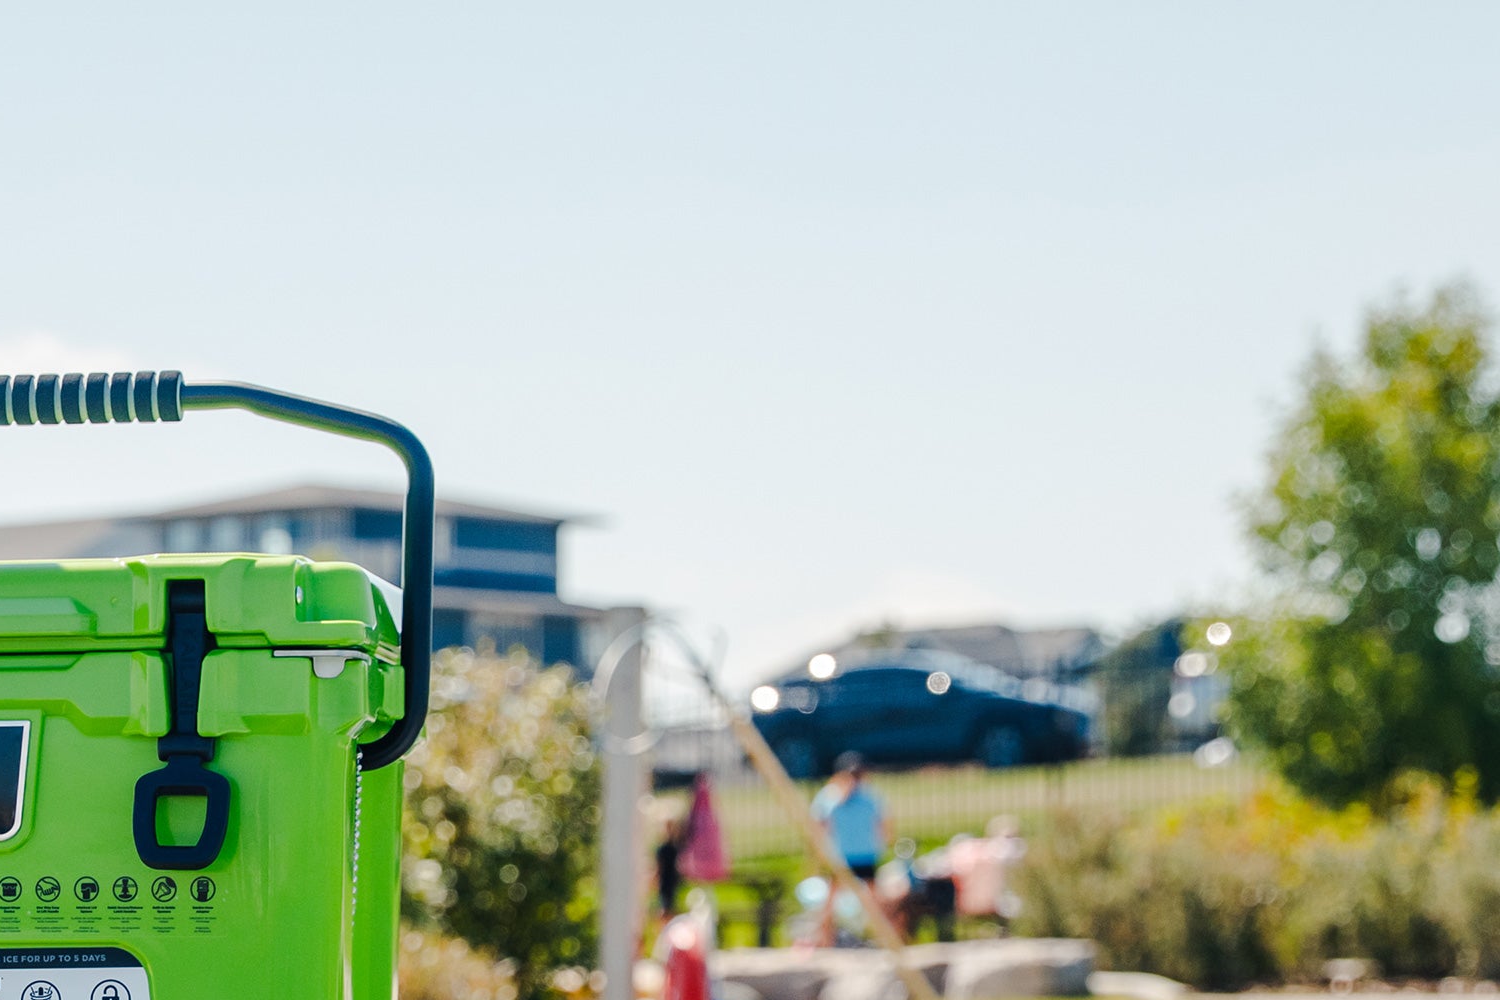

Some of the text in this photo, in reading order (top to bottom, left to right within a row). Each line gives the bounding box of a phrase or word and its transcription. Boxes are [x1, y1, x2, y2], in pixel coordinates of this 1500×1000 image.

[3, 955, 19, 963] ICE
[21, 955, 41, 963] FOR
[43, 954, 56, 963] UP
[58, 954, 71, 962] TO
[74, 954, 79, 962] 5
[82, 954, 106, 962] DAYS
